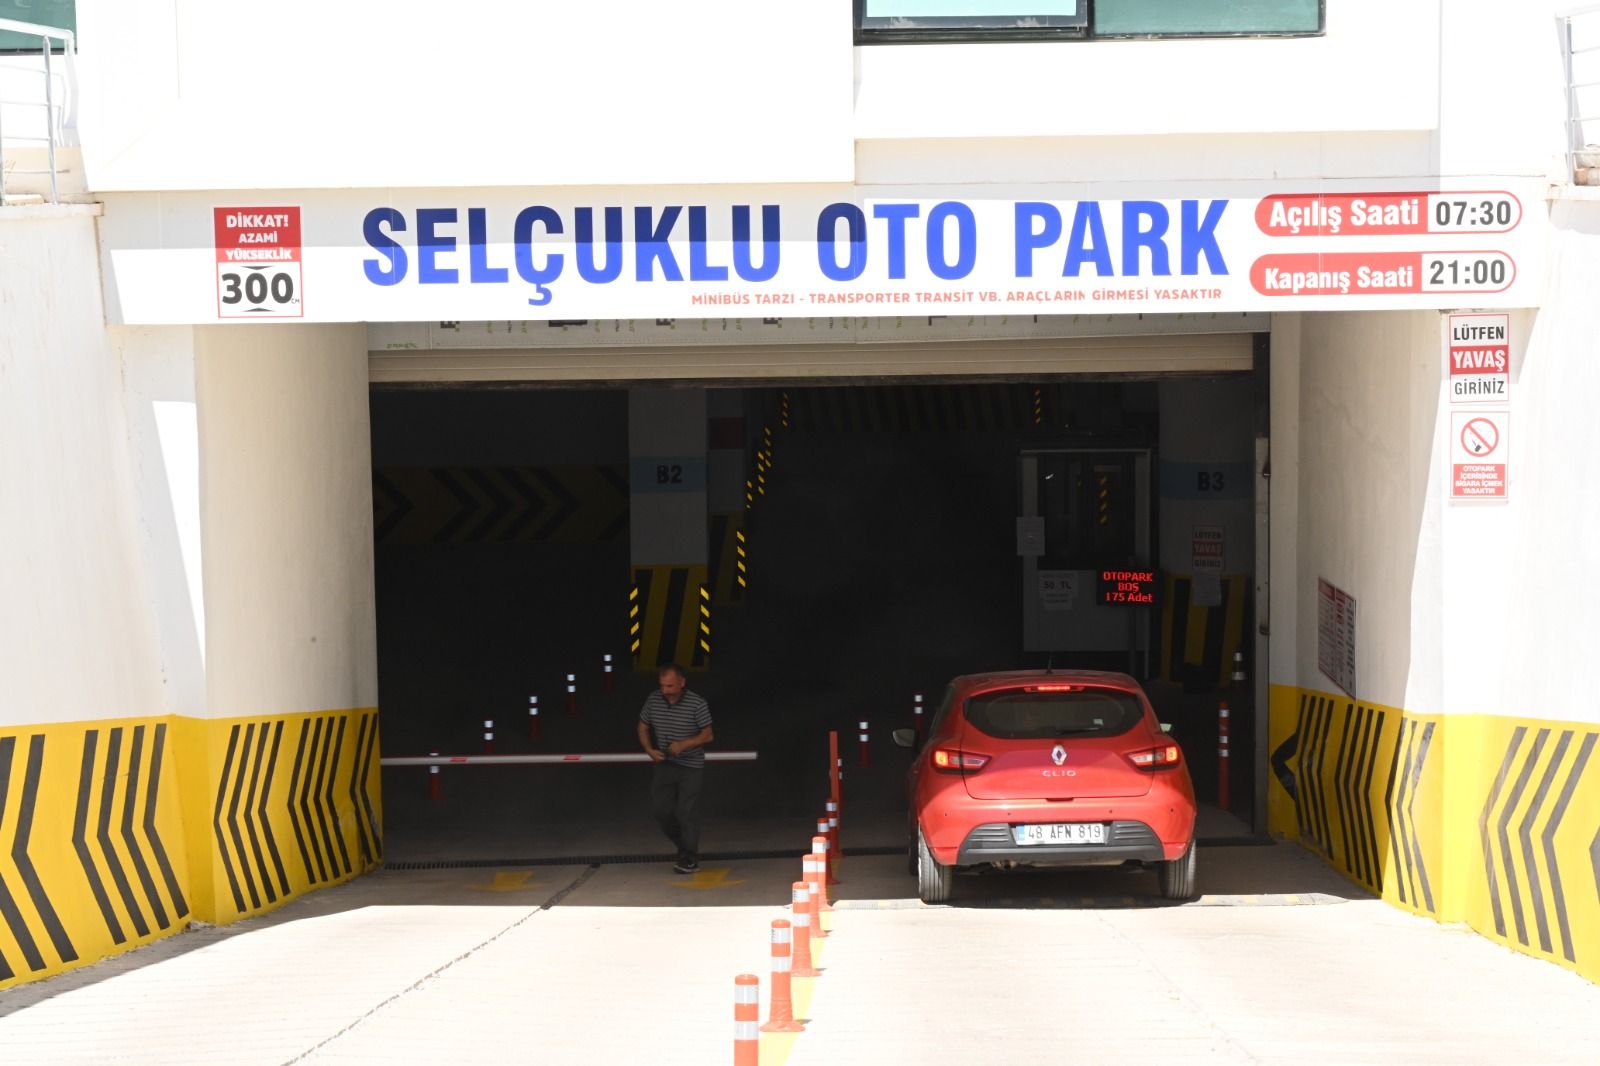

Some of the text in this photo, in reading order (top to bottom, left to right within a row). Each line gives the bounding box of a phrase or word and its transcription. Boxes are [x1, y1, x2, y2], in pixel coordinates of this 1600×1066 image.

[226, 211, 289, 228] DİKKAT!
[1269, 199, 1512, 234] Açılış Saati 07:30
[238, 230, 278, 243] AZAMİ
[225, 247, 293, 260] YÜKSEKLİK
[363, 200, 1229, 306] SELÇUKLU OTO PARK
[1264, 259, 1505, 294] Kapanış Saati 21:00
[221, 272, 294, 304] 300
[691, 292, 751, 305] MİNİBÜS
[754, 293, 795, 304] TARZI
[808, 292, 911, 304] TRANSPORTER
[914, 289, 974, 303] TRANSİT
[978, 291, 1002, 303] VB.
[1005, 289, 1087, 304] ARAÇLARIN
[1091, 287, 1150, 301] GİRMESİ
[1153, 288, 1224, 301] YASAKTIR
[1453, 323, 1505, 341] LÜTFEN
[1452, 349, 1506, 373] YAVAŞ
[1454, 378, 1505, 396] GİRİNİZ
[656, 464, 683, 484] B2
[1198, 471, 1225, 492] B3
[1103, 571, 1153, 582] OTOPARK
[1118, 582, 1139, 594] BOŞ
[1106, 592, 1153, 603] 175 Adet
[1028, 825, 1101, 839] 48 AFN 819
